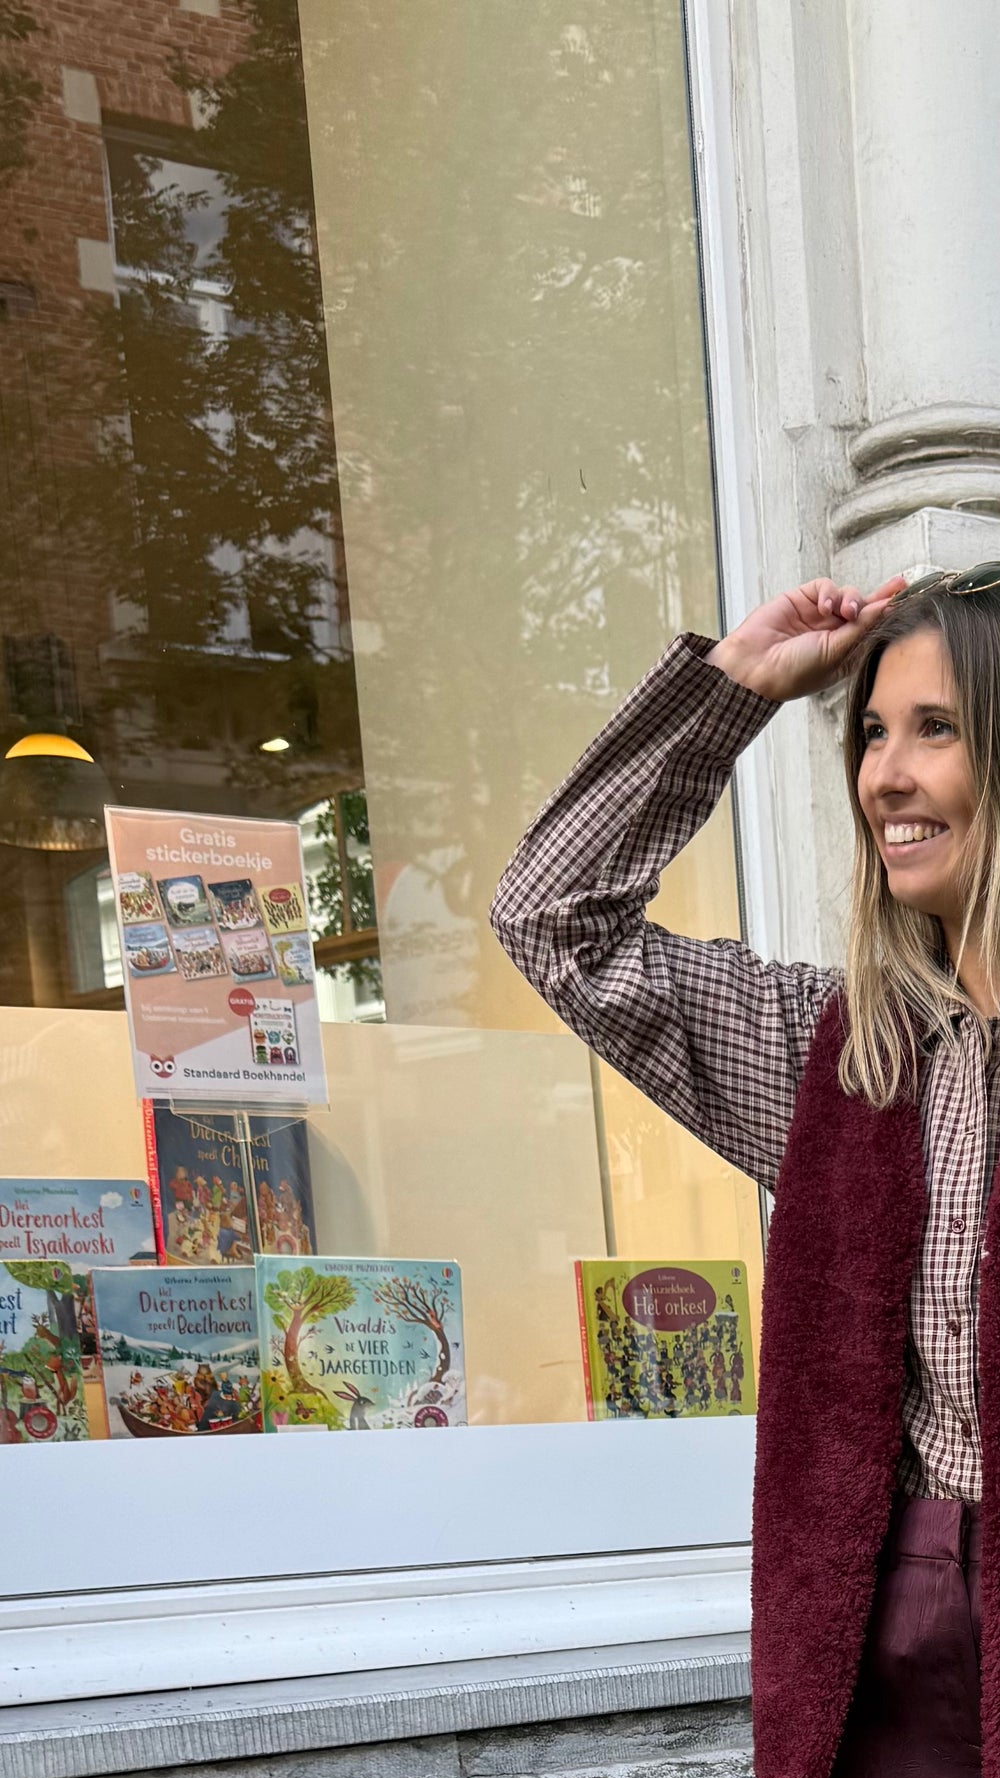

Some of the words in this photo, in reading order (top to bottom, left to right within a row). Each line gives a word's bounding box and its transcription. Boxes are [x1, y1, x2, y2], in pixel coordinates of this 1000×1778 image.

[180, 827, 236, 848] Gratis
[146, 844, 273, 872] stickerboekje
[183, 1067, 240, 1080] Standaard
[243, 1070, 306, 1082] Boekhandel
[222, 1145, 269, 1171] Chin
[0, 1204, 104, 1229] Dierenorkest
[24, 1231, 115, 1259] Tsjaikovski
[642, 1283, 696, 1295] Muziekboek
[139, 1290, 252, 1313] Dierenorkest
[633, 1295, 661, 1316] Het
[665, 1296, 707, 1315] orkest
[148, 1317, 175, 1333] speelt
[177, 1313, 252, 1335] Beethoven
[334, 1316, 396, 1335] Vivaldi's
[345, 1343, 354, 1353] DE
[358, 1340, 390, 1355] VIER
[319, 1359, 416, 1377] JAARGETIJDEN
